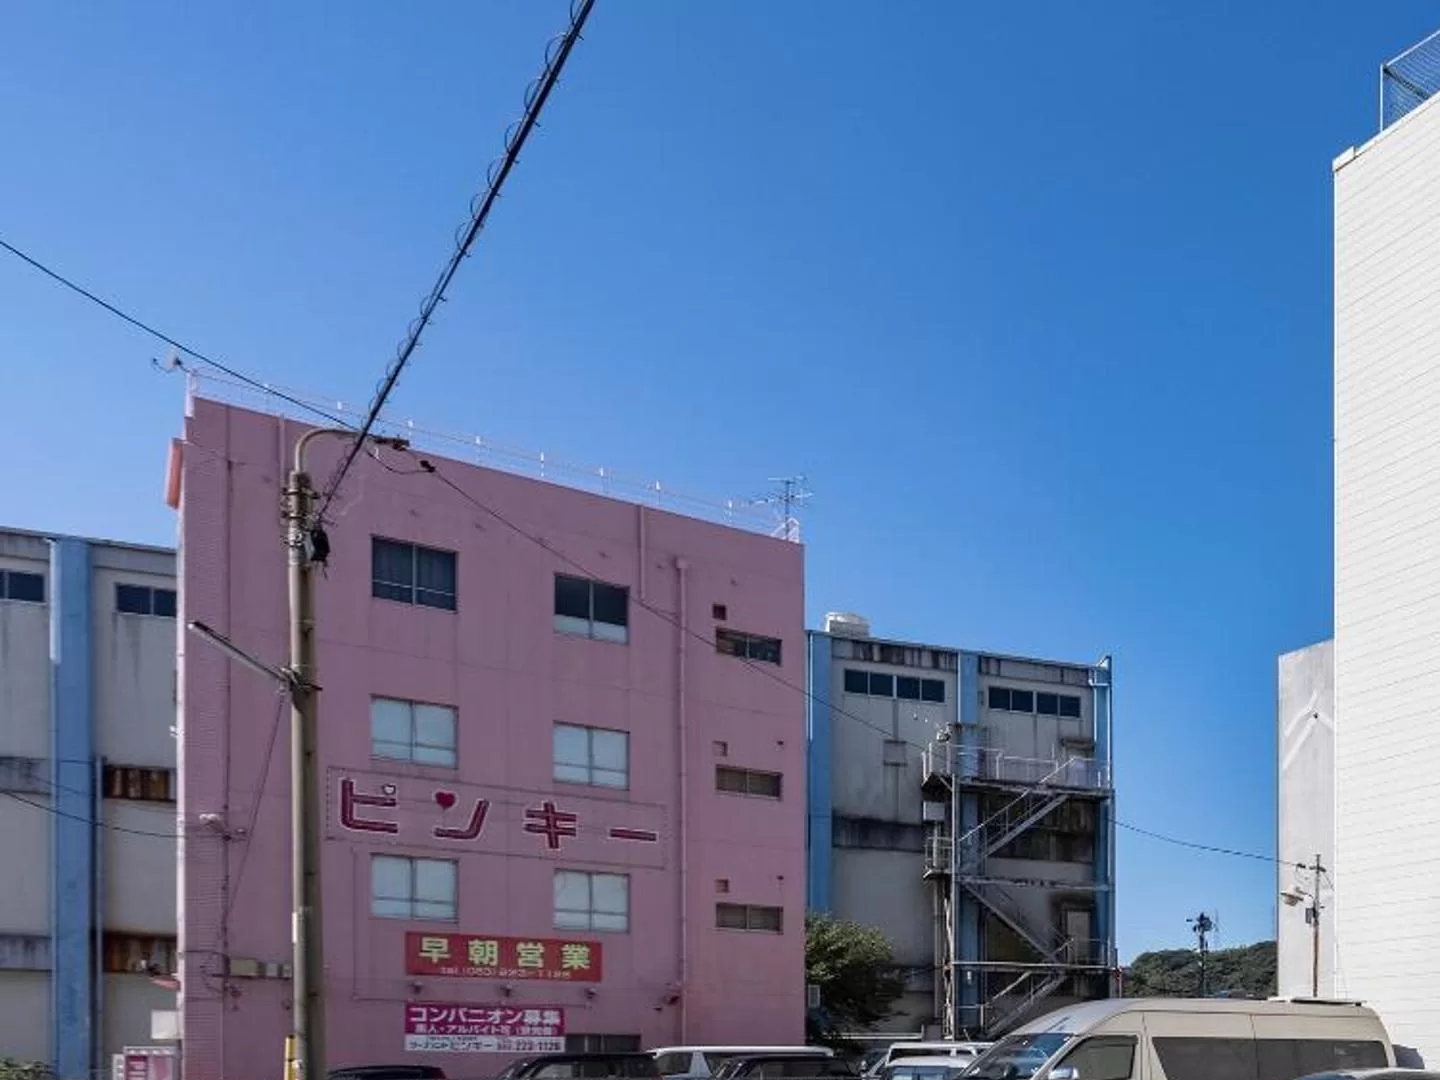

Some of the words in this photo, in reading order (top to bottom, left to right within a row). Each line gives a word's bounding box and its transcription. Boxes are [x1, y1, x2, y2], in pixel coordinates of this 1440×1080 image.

[341, 779, 657, 850] ピンキー
[419, 936, 591, 970] 早朝営業
